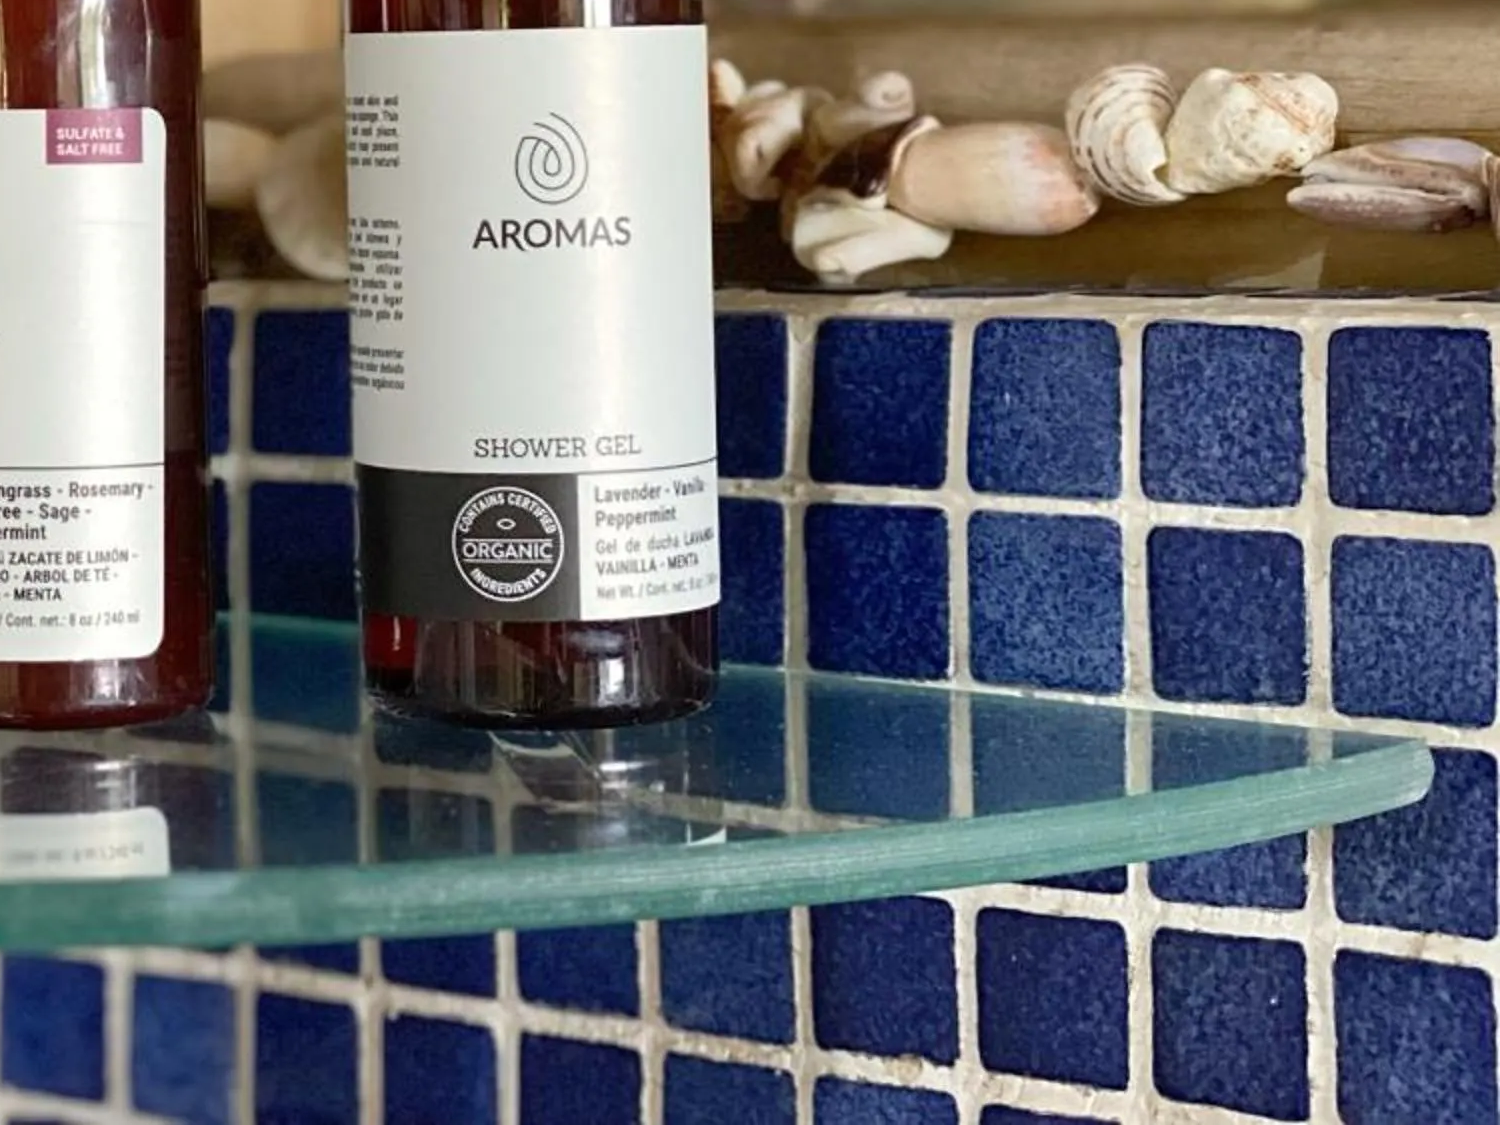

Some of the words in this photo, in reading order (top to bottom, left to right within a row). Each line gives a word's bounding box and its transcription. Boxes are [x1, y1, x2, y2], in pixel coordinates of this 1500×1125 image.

[56, 127, 111, 140] SULFATE
[115, 127, 125, 139] &
[56, 143, 89, 155] SALT
[91, 143, 123, 155] FREE
[473, 216, 632, 251] AROMAS
[474, 437, 587, 459] SHOWER
[595, 434, 642, 457] GEL
[69, 481, 143, 500] Rosemary
[594, 483, 661, 503] Lavender
[39, 503, 80, 522] Sage
[459, 492, 505, 533] CONTAINS
[507, 492, 557, 534] CERTIFIED
[595, 506, 676, 531] Peppermint
[8, 551, 62, 565] ZACATE
[66, 551, 83, 565] DE
[463, 541, 553, 558] ORGANIC
[74, 569, 92, 582] DE
[470, 567, 547, 595] INGREDIENTS
[13, 587, 62, 601] MENTA
